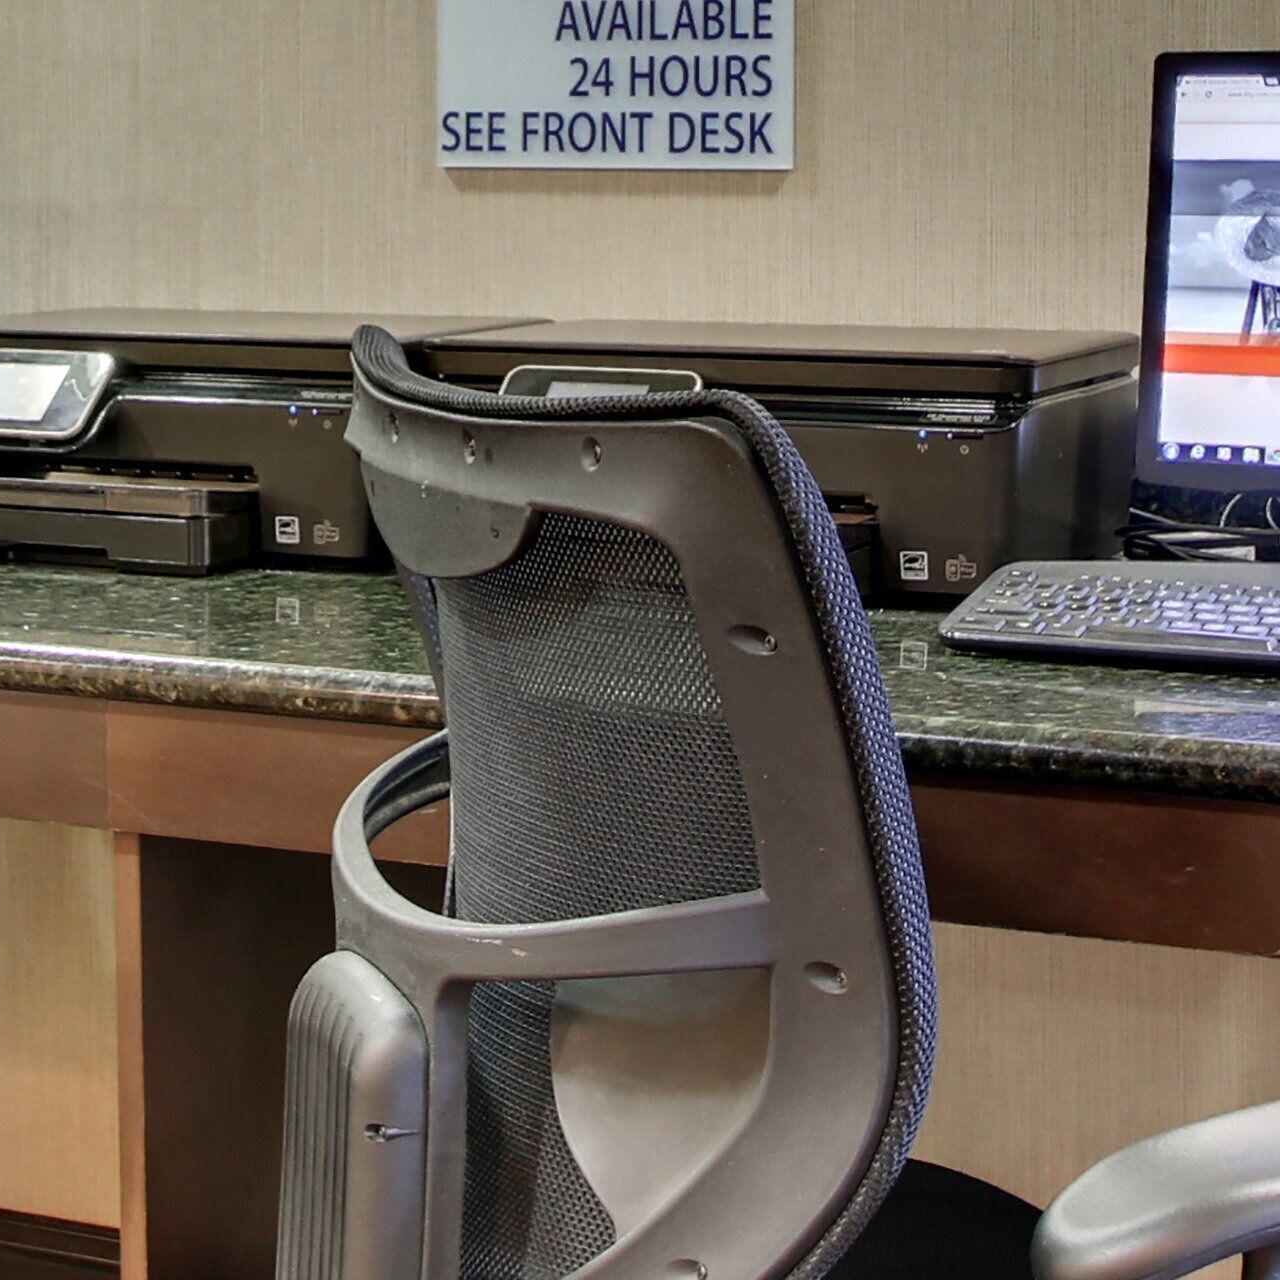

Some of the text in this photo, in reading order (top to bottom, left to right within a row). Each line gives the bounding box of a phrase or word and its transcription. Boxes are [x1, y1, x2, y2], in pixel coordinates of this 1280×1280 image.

[569, 54, 773, 98] 24 HOURS
[441, 111, 774, 155] SEE FRONT DESK
